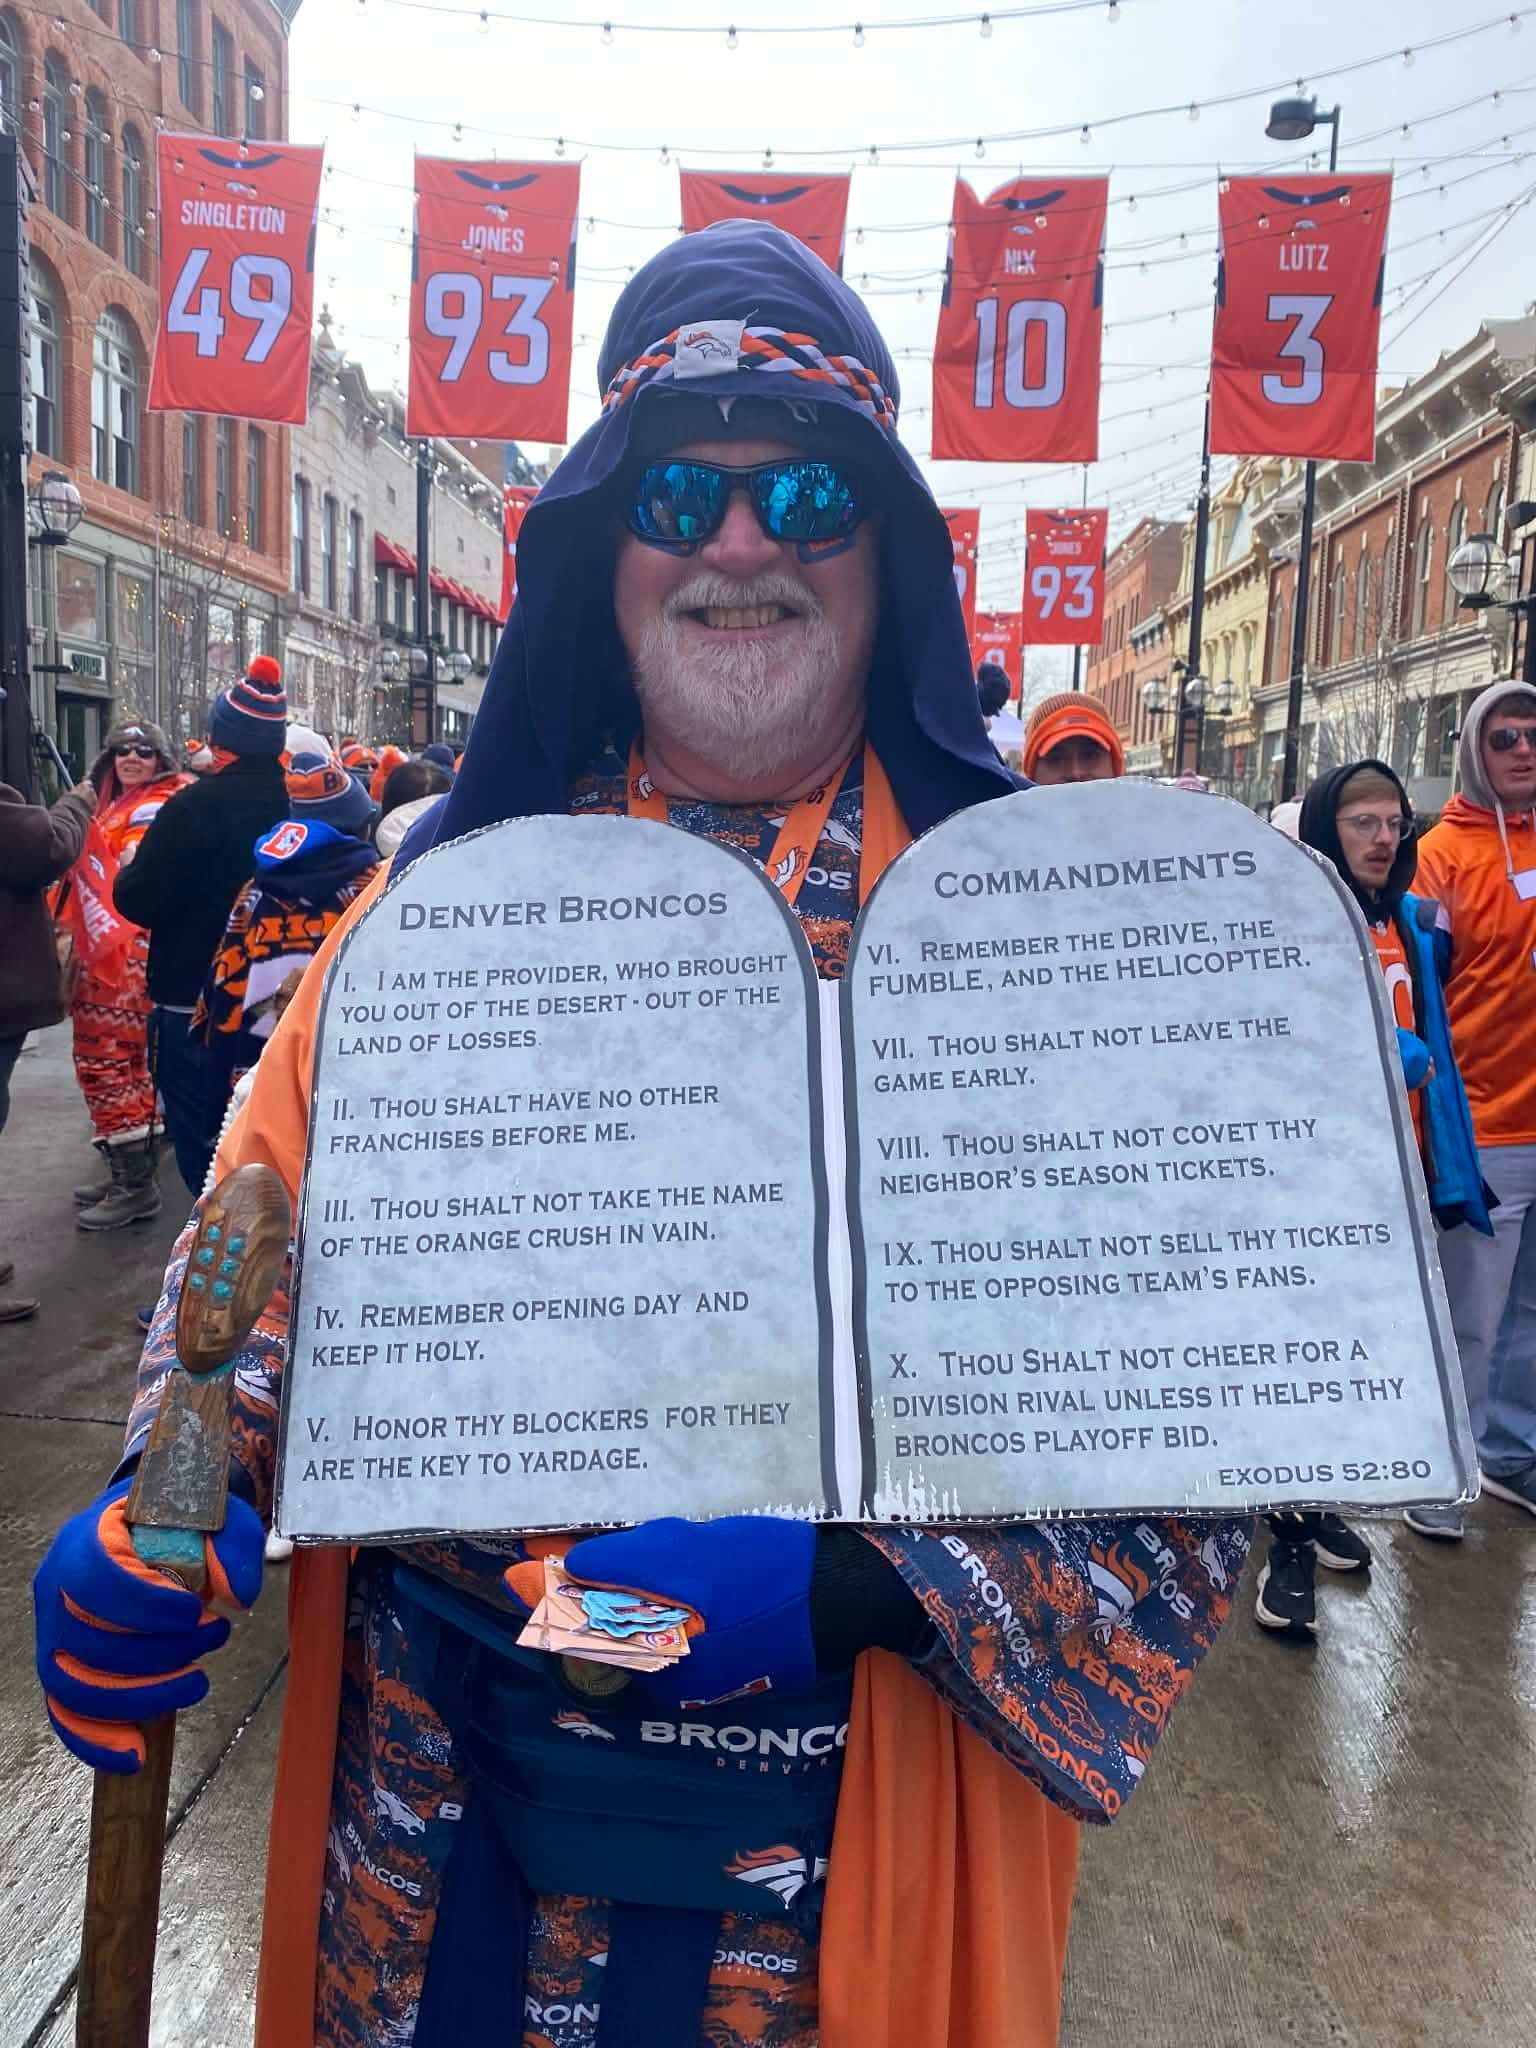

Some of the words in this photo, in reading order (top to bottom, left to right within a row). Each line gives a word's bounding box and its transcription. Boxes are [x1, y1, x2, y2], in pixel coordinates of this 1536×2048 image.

[180, 200, 286, 235] SINGLETON
[461, 223, 525, 254] JONES
[1279, 243, 1329, 271] LUTZ
[167, 248, 293, 364] 49
[423, 271, 551, 385] 93
[973, 298, 1067, 409] 10
[1261, 295, 1336, 406] 3
[1031, 564, 1095, 619] 93
[934, 850, 1257, 899] COMMANDMENTS
[399, 902, 547, 931] DENVER
[559, 892, 728, 923] BRONCOS
[867, 944, 900, 965] VI.
[920, 936, 1059, 962] REMEMBER
[1065, 932, 1115, 952] THE
[1121, 922, 1218, 949] DRIVE,
[1223, 919, 1275, 941] THE
[343, 972, 356, 993] I.
[378, 970, 385, 991] I
[391, 972, 426, 991] AM
[433, 970, 479, 989] THE
[486, 964, 608, 987] PROVIDER,
[615, 960, 670, 981] WHO
[677, 954, 788, 977] BROUGHT
[869, 968, 993, 997] FUMBLE,
[1001, 967, 1053, 988] AND
[1059, 963, 1110, 984] THE
[1116, 946, 1311, 980] HELICOPTER.
[340, 1004, 386, 1024] YOU
[393, 1002, 441, 1022] OUT
[446, 1000, 478, 1019] OF
[483, 998, 529, 1018] THE
[537, 994, 628, 1016] DESERT
[645, 990, 692, 1010] OUT
[698, 989, 729, 1008] OF
[734, 986, 780, 1005] THE
[338, 1035, 402, 1056] LAND
[409, 1034, 441, 1053] OF
[447, 1029, 542, 1051] LOSSES.
[871, 1037, 914, 1060] VII.
[927, 1034, 997, 1057] THOU
[1004, 1030, 1085, 1053] SHALT
[1091, 1026, 1143, 1048] NOT
[1151, 1021, 1233, 1044] LEAVE
[1238, 1016, 1291, 1038] THE
[874, 1071, 945, 1093] GAME
[951, 1066, 1035, 1089] EARLY.
[333, 1098, 355, 1121] II.
[369, 1096, 437, 1119] THOU
[444, 1094, 522, 1116] SHALT
[528, 1091, 591, 1113] HAVE
[599, 1089, 633, 1109] NO
[639, 1085, 719, 1107] OTHER
[330, 1129, 484, 1155] FRANCHISES
[491, 1124, 587, 1147] BEFORE
[595, 1122, 636, 1143] ME.
[877, 1135, 930, 1161] VIII.
[942, 1133, 1014, 1157] THOU
[1022, 1130, 1105, 1153] SHALT
[1112, 1127, 1165, 1149] NOT
[1172, 1121, 1259, 1146] COVET
[1265, 1118, 1316, 1140] THY
[880, 1167, 1037, 1196] NEIGHBOR'S
[1043, 1163, 1149, 1187] SEASON
[1155, 1156, 1275, 1182] TICKETS.
[324, 1199, 355, 1223] III.
[370, 1197, 439, 1221] THOU
[446, 1194, 526, 1218] SHALT
[533, 1191, 583, 1213] NOT
[588, 1189, 651, 1210] TAKE
[657, 1186, 705, 1207] THE
[713, 1182, 784, 1205] NAME
[320, 1237, 354, 1258] OF
[360, 1235, 409, 1256] THE
[415, 1229, 521, 1254] ORANGE
[527, 1225, 611, 1249] CRUSH
[620, 1223, 644, 1244] IN
[651, 1220, 716, 1243] VAIN.
[930, 1240, 1002, 1264] THOU
[1010, 1237, 1092, 1261] SHALT
[1099, 1234, 1153, 1257] NOT
[1159, 1232, 1221, 1255] SELL
[1228, 1229, 1276, 1251] THY
[1283, 1223, 1391, 1249] TICKETS
[884, 1281, 919, 1303] TO
[924, 1279, 977, 1301] THE
[984, 1273, 1121, 1299] OPPOSING
[1127, 1268, 1229, 1294] TEAM'S
[1236, 1265, 1316, 1289] FANS.
[315, 1305, 344, 1330] IV.
[360, 1302, 505, 1329] REMEMBER
[512, 1296, 625, 1322] OPENING
[634, 1293, 682, 1316] DAY
[695, 1291, 749, 1313] AND
[312, 1344, 379, 1367] KEEP
[386, 1342, 409, 1364] IT
[415, 1339, 485, 1363] HOLY.
[889, 1353, 917, 1379] X.
[938, 1351, 1014, 1377] THOU
[1022, 1348, 1112, 1374] SHALT
[1119, 1347, 1175, 1371] NOT
[1183, 1343, 1277, 1368] CHEER
[1284, 1340, 1341, 1364] FOR
[1350, 1339, 1369, 1361] A
[893, 1392, 1009, 1418] DIVISION
[1017, 1389, 1096, 1414] RIVAL
[1103, 1386, 1212, 1412] UNLESS
[1220, 1384, 1244, 1408] IT
[1252, 1380, 1343, 1406] HELPS
[1349, 1377, 1404, 1402] THY
[306, 1417, 329, 1443] V.
[353, 1415, 448, 1441] HONOR
[455, 1414, 505, 1437] THY
[512, 1408, 649, 1435] BLOCKERS
[665, 1405, 717, 1429] FOR
[723, 1402, 790, 1426] THEY
[895, 1431, 1026, 1458] BRONCOS
[1034, 1426, 1154, 1453] PLAYOFF
[1162, 1425, 1218, 1449] BID.
[302, 1458, 355, 1482] ARE
[362, 1456, 413, 1480] THE
[420, 1454, 471, 1478] KEY
[477, 1452, 511, 1475] TO
[519, 1447, 648, 1474] YARDAGE.
[1218, 1464, 1334, 1486] EXODUS
[1342, 1459, 1432, 1482] 52:80
[940, 1534, 1036, 1669] BRONCOS
